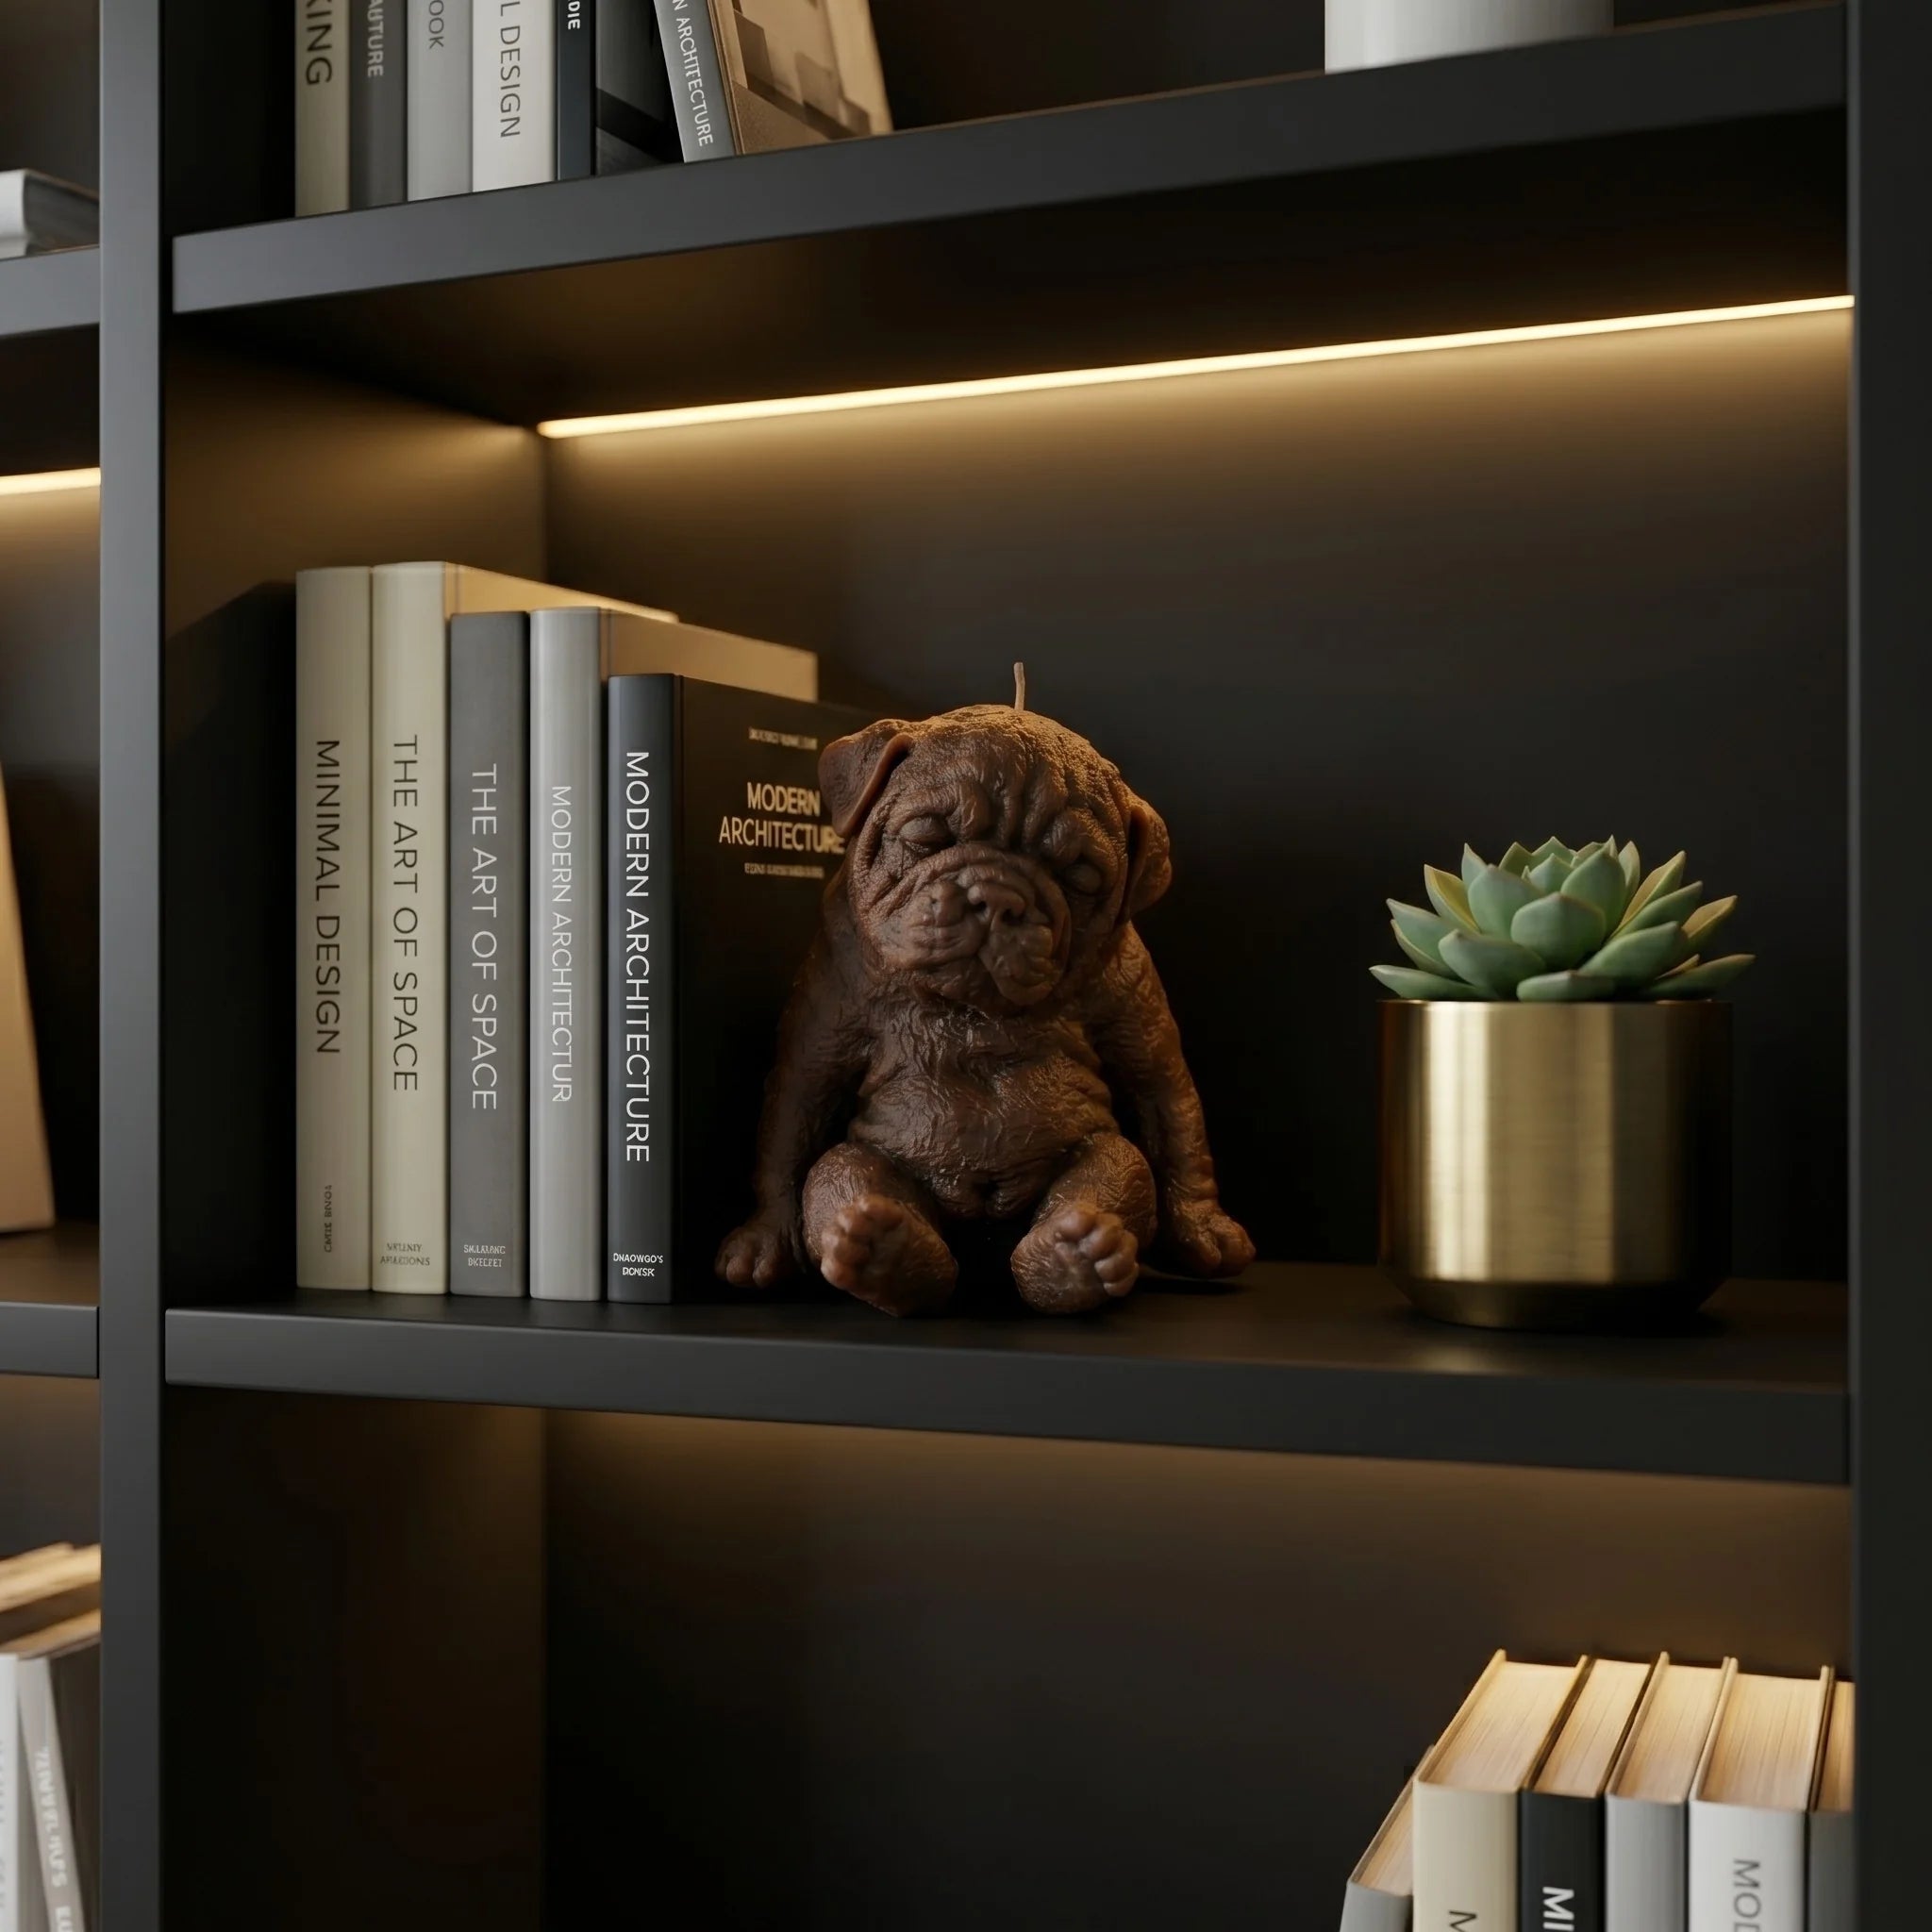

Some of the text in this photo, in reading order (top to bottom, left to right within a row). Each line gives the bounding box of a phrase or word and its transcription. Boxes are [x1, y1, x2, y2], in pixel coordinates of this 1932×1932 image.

[568, 0, 580, 29] DIE
[501, 25, 520, 137] DESIGN
[675, 17, 713, 147] ARCHITECTURE
[552, 787, 572, 901] MODERN
[719, 815, 845, 855] ARCHITECTURE
[747, 782, 820, 816] MODERN
[316, 741, 340, 1053] MINIMAL DESIGN
[393, 735, 418, 1090] THE ART OF SPACE
[472, 764, 497, 1109] THE ART OF SPACE
[626, 753, 650, 1161] MODERN ARCHITECTURE
[1543, 1887, 1574, 1931] MI
